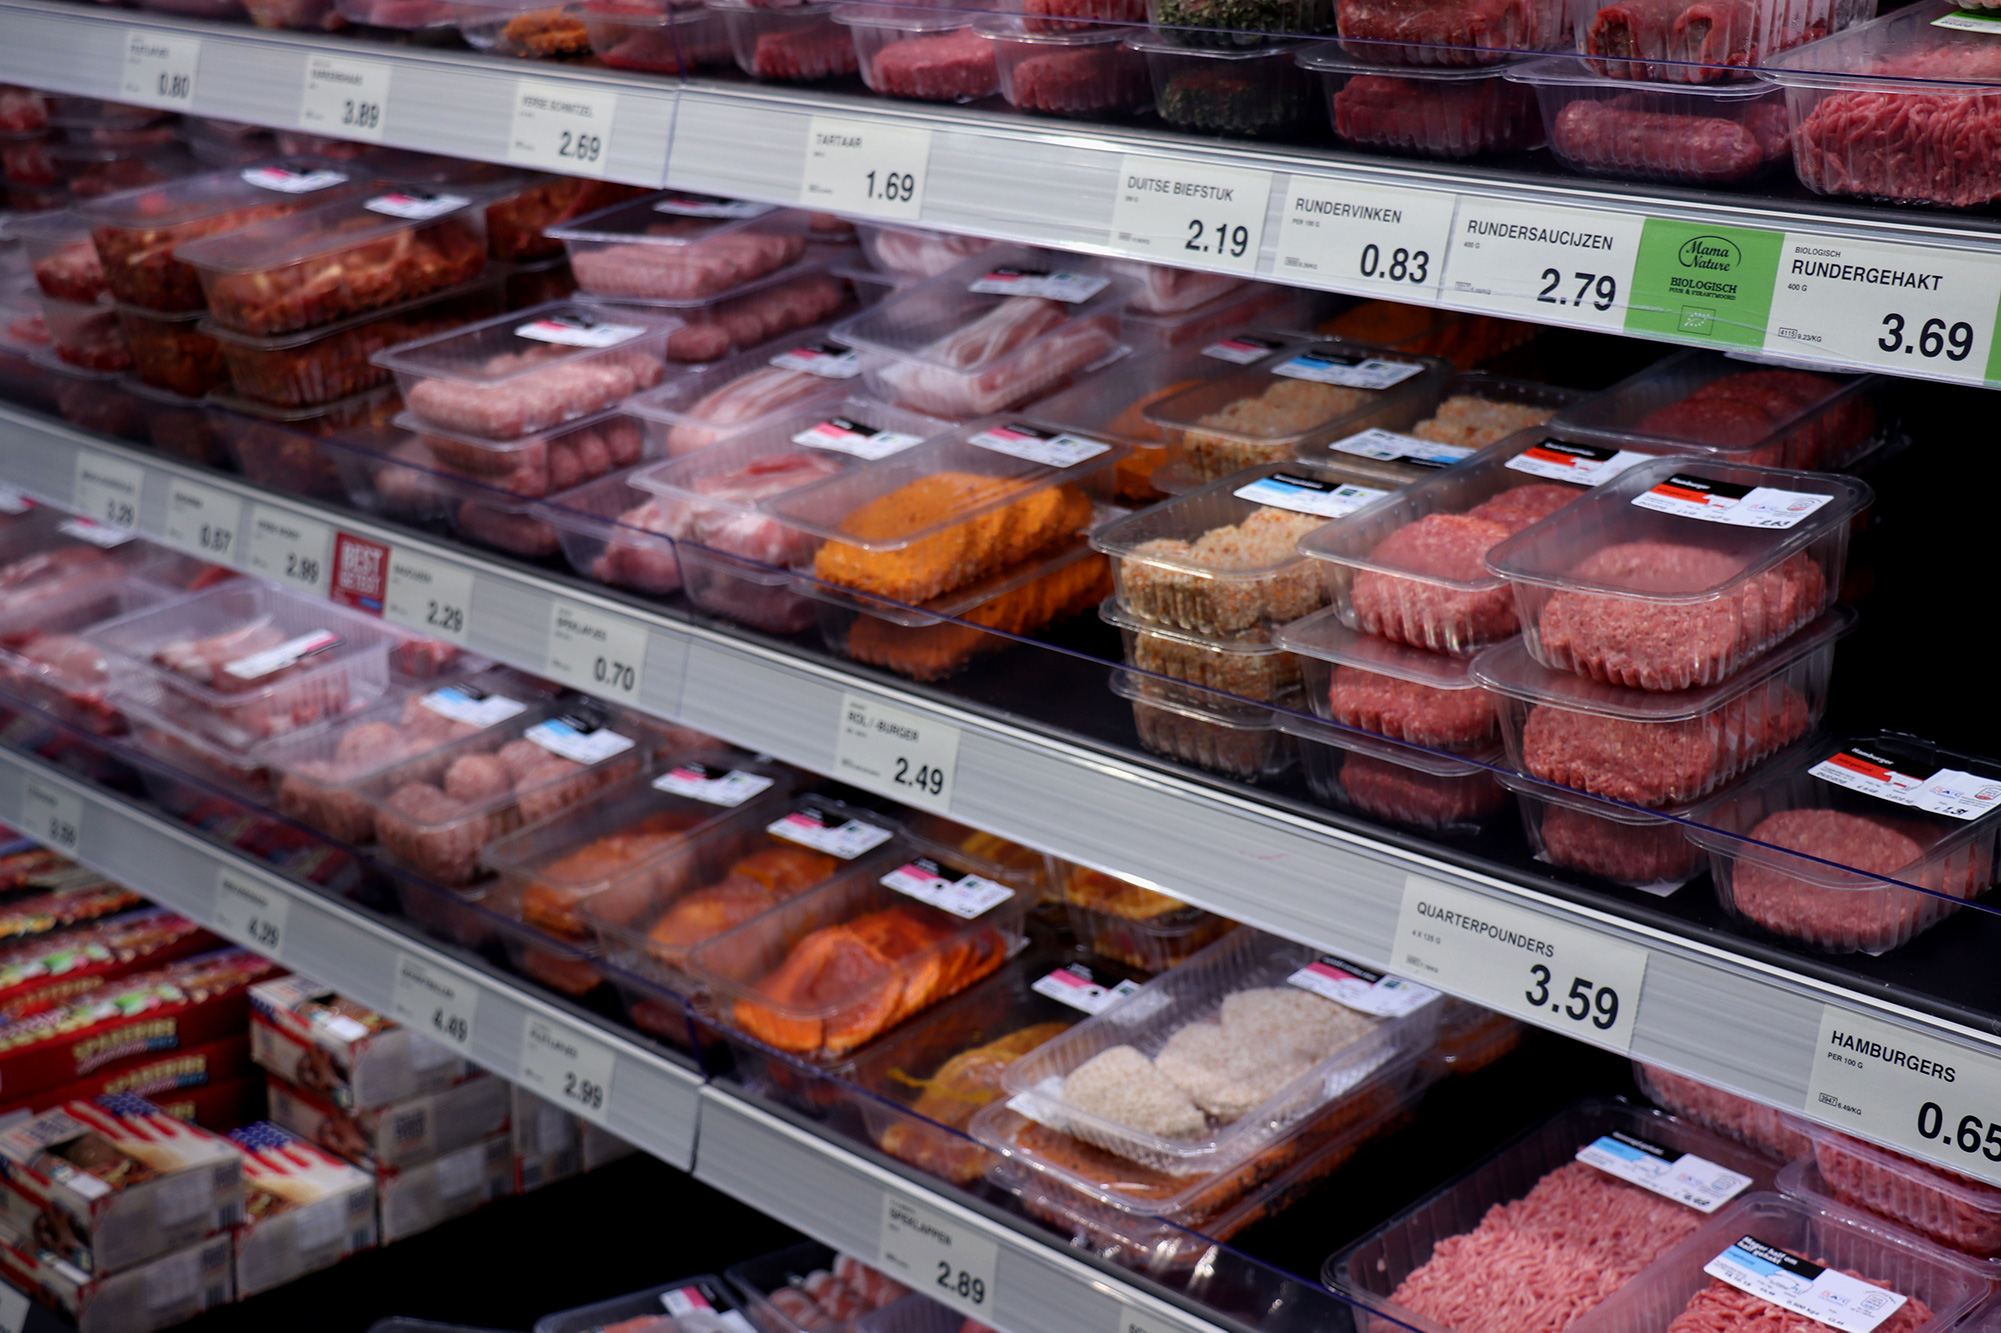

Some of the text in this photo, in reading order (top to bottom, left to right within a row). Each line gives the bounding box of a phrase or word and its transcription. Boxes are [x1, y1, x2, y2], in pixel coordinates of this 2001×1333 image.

[558, 131, 601, 162] 2.69
[816, 133, 863, 149] TARTAAR
[866, 169, 915, 202] 1.69
[1127, 176, 1234, 201] DUITSE BIEFSTUK
[1295, 198, 1402, 224] RUNDERVINKEN
[1185, 219, 1249, 257] 2.19
[1467, 219, 1614, 250] RUNDERSAUCIJZEN
[1686, 241, 1730, 258] Mama
[1360, 244, 1429, 284] 0.83
[1689, 254, 1731, 272] Nature
[1794, 246, 1842, 258] BIOLOGISCH
[1537, 267, 1617, 312] 2.79
[1670, 277, 1738, 294] BIOLOGISCH
[1787, 283, 1807, 292] 400 G
[1791, 259, 1943, 291] RUNDERGEHAKT
[1878, 313, 1974, 361] 3.69
[341, 541, 383, 575] BEST
[427, 600, 463, 633] 2.29
[594, 656, 635, 691] 0.70
[895, 757, 943, 795] 2.49
[1416, 901, 1555, 958] QUARTERPOUNDERS
[1525, 964, 1619, 1030] 3.59
[433, 1008, 468, 1043] 4.49
[1828, 1051, 1863, 1069] PER 100 G
[1831, 1030, 1956, 1083] HAMBURGERS
[564, 1071, 604, 1110] 2.99
[1917, 1101, 2001, 1162] 0.65
[937, 1260, 985, 1304] 2.89
